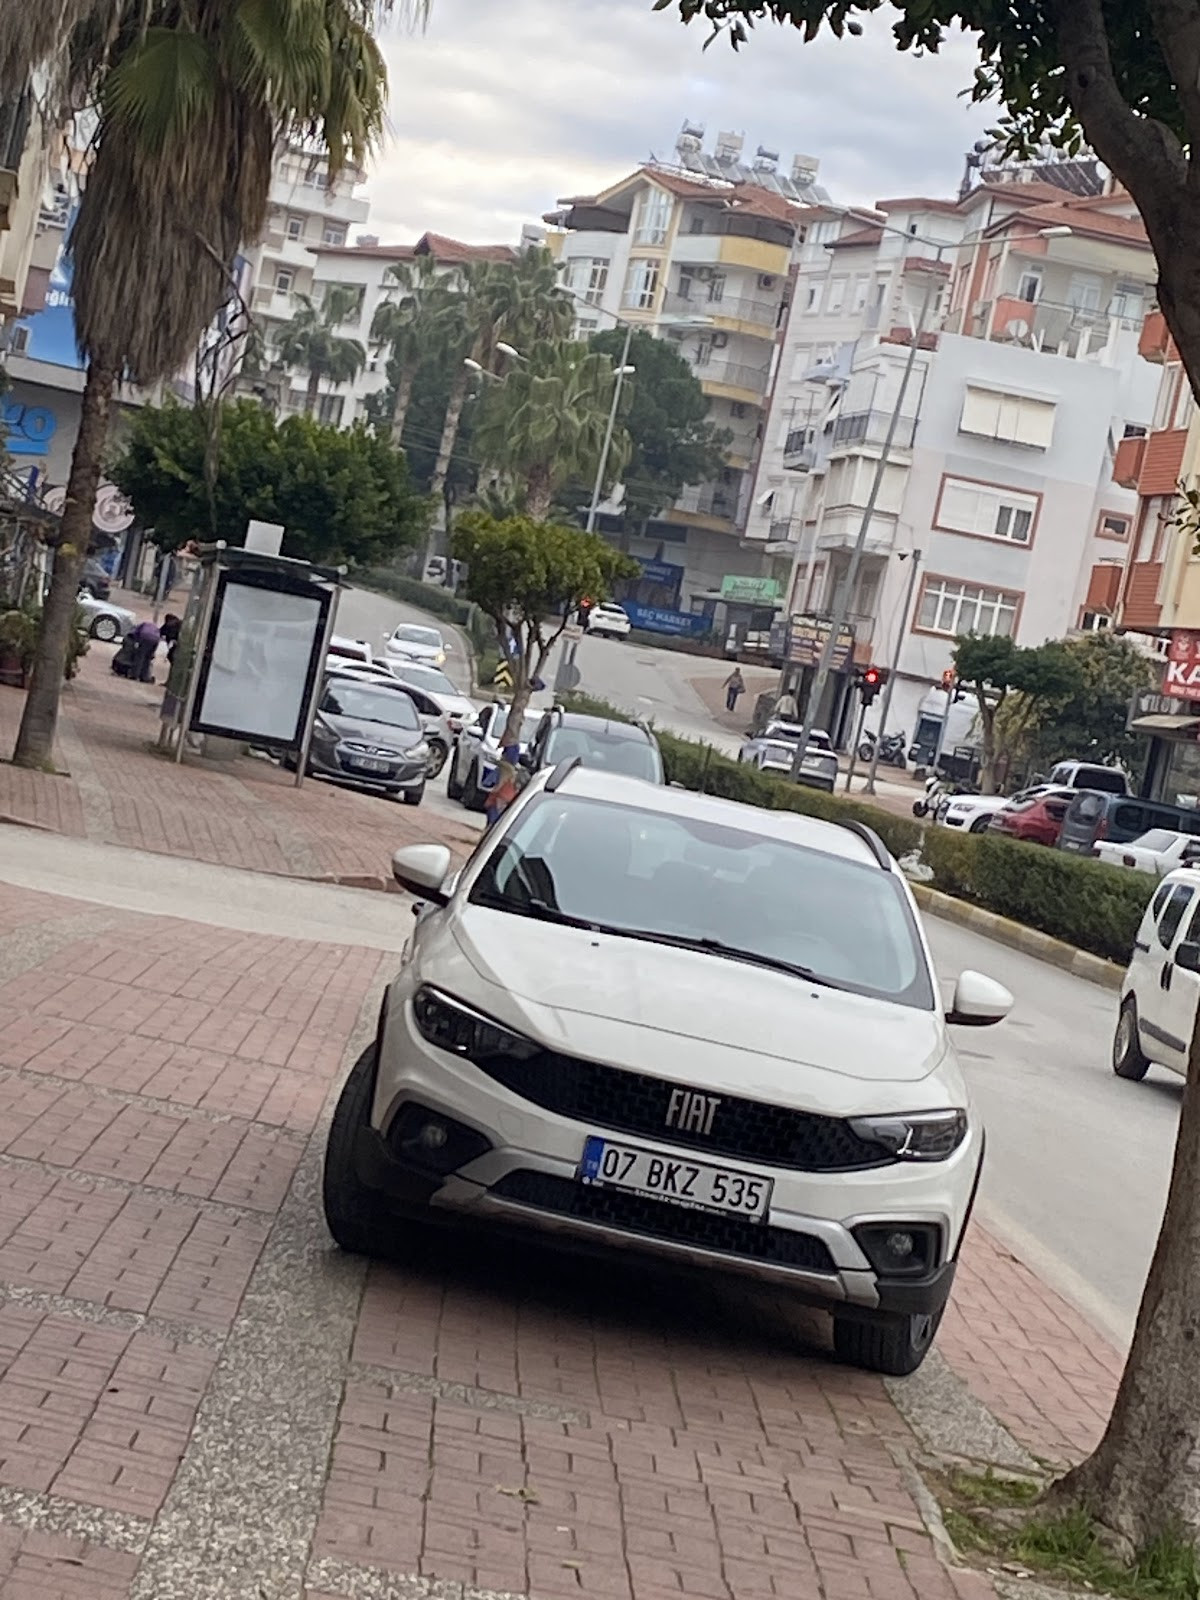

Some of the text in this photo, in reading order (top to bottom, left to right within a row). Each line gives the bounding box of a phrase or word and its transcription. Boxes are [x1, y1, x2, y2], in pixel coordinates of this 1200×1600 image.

[656, 613, 691, 627] MARKET
[665, 1088, 722, 1136] FIAT
[602, 1149, 638, 1181] 07
[646, 1159, 700, 1197] BKZ
[711, 1173, 764, 1211] 535
